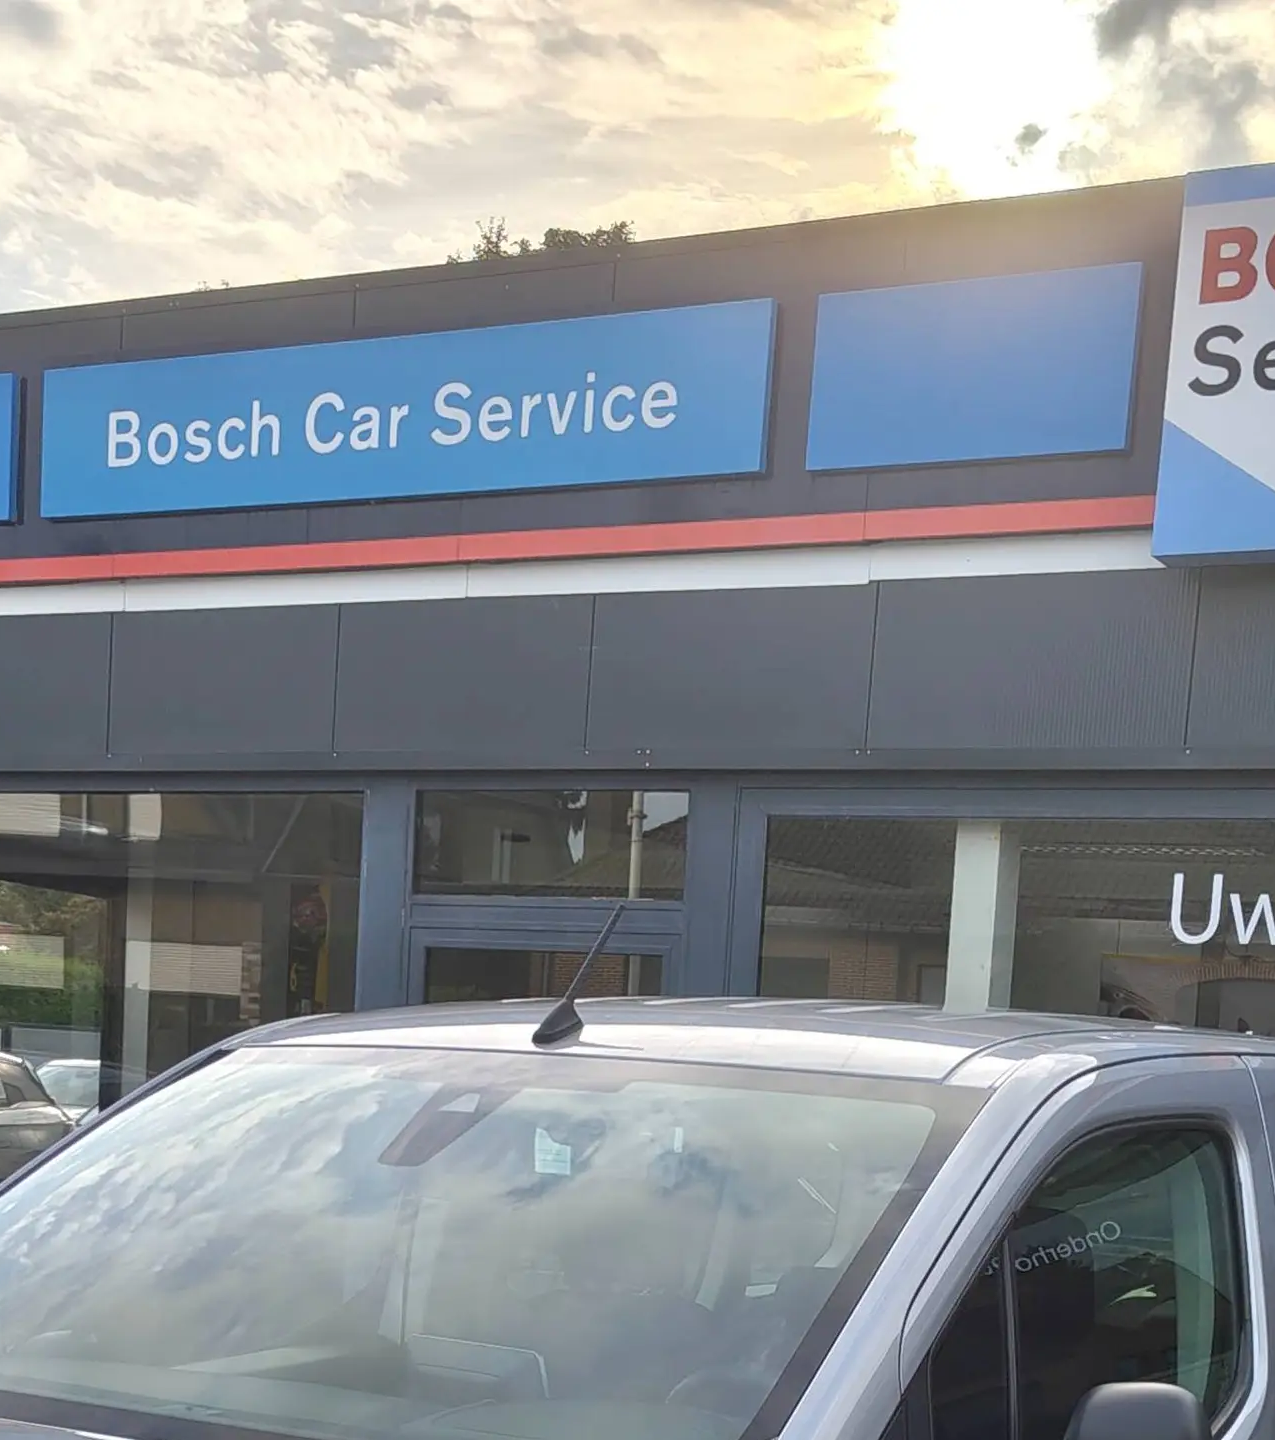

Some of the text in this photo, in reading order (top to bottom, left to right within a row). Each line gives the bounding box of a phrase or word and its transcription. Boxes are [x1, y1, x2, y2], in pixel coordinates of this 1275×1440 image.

[107, 371, 679, 468] Bosch Car Service
